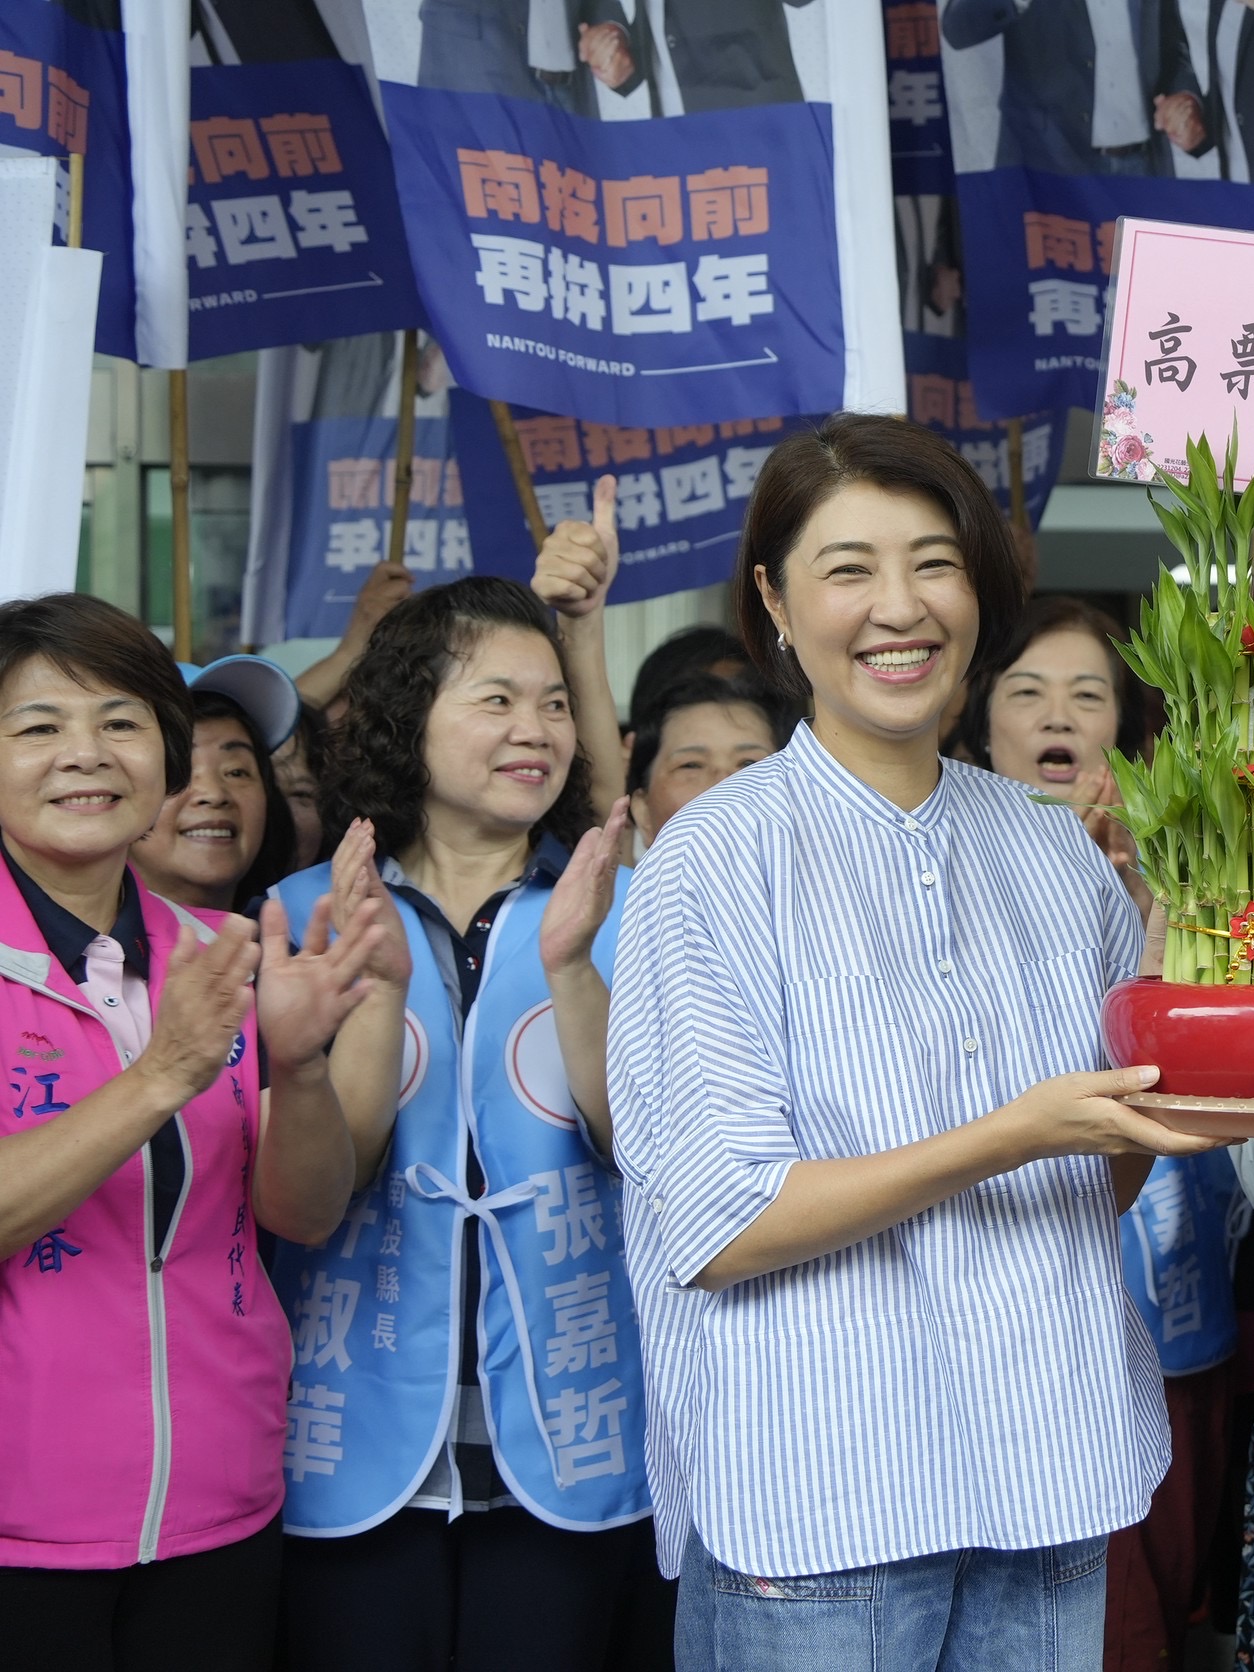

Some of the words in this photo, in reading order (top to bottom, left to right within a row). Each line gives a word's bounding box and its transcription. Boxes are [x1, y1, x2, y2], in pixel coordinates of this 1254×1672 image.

[187, 113, 343, 185] 向前
[456, 147, 769, 247] 南投向前
[486, 333, 557, 361] NANTOU
[557, 349, 636, 378] FORWARD
[527, 1160, 628, 1489] 張嘉哲
